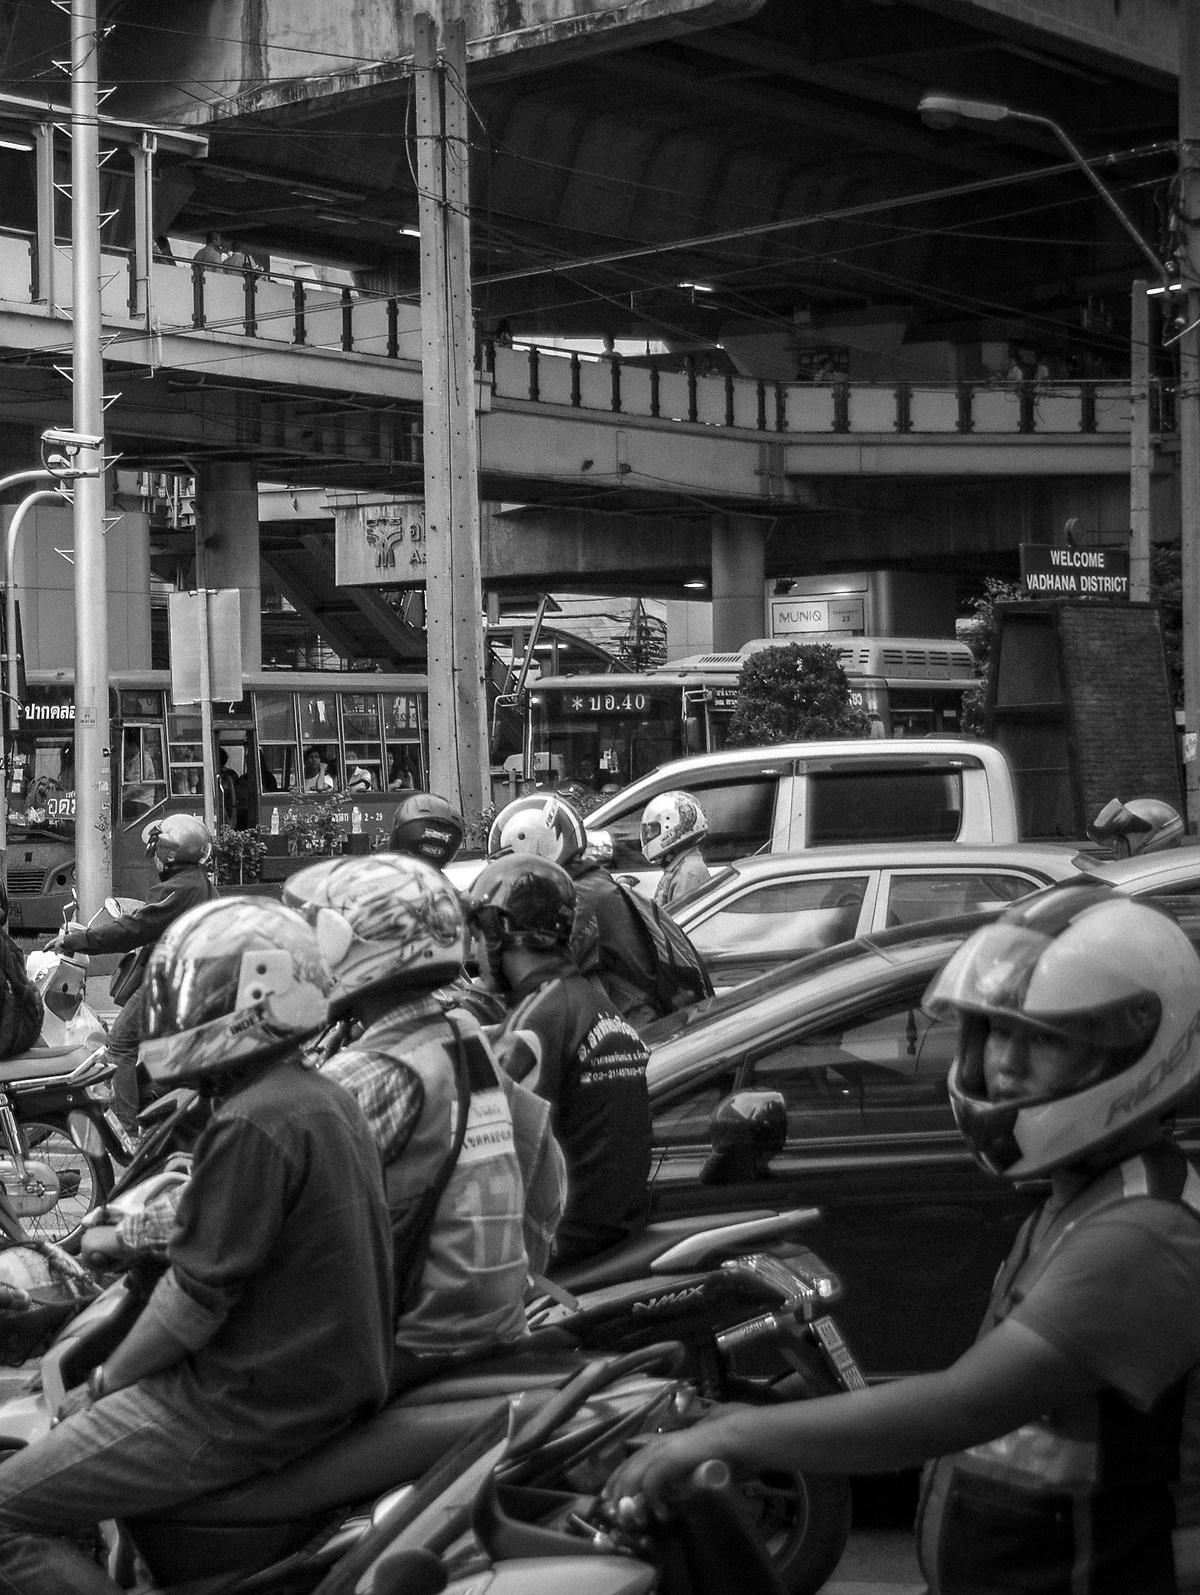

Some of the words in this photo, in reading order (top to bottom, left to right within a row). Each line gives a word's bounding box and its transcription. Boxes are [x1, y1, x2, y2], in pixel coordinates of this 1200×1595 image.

[1050, 550, 1105, 568] WELCOME
[1026, 573, 1077, 591] VADHANA
[1080, 575, 1128, 592] DISTRICT
[779, 610, 823, 623] MUNIQ
[24, 703, 76, 720] ปากคลอ
[632, 1284, 705, 1314] NMAX
